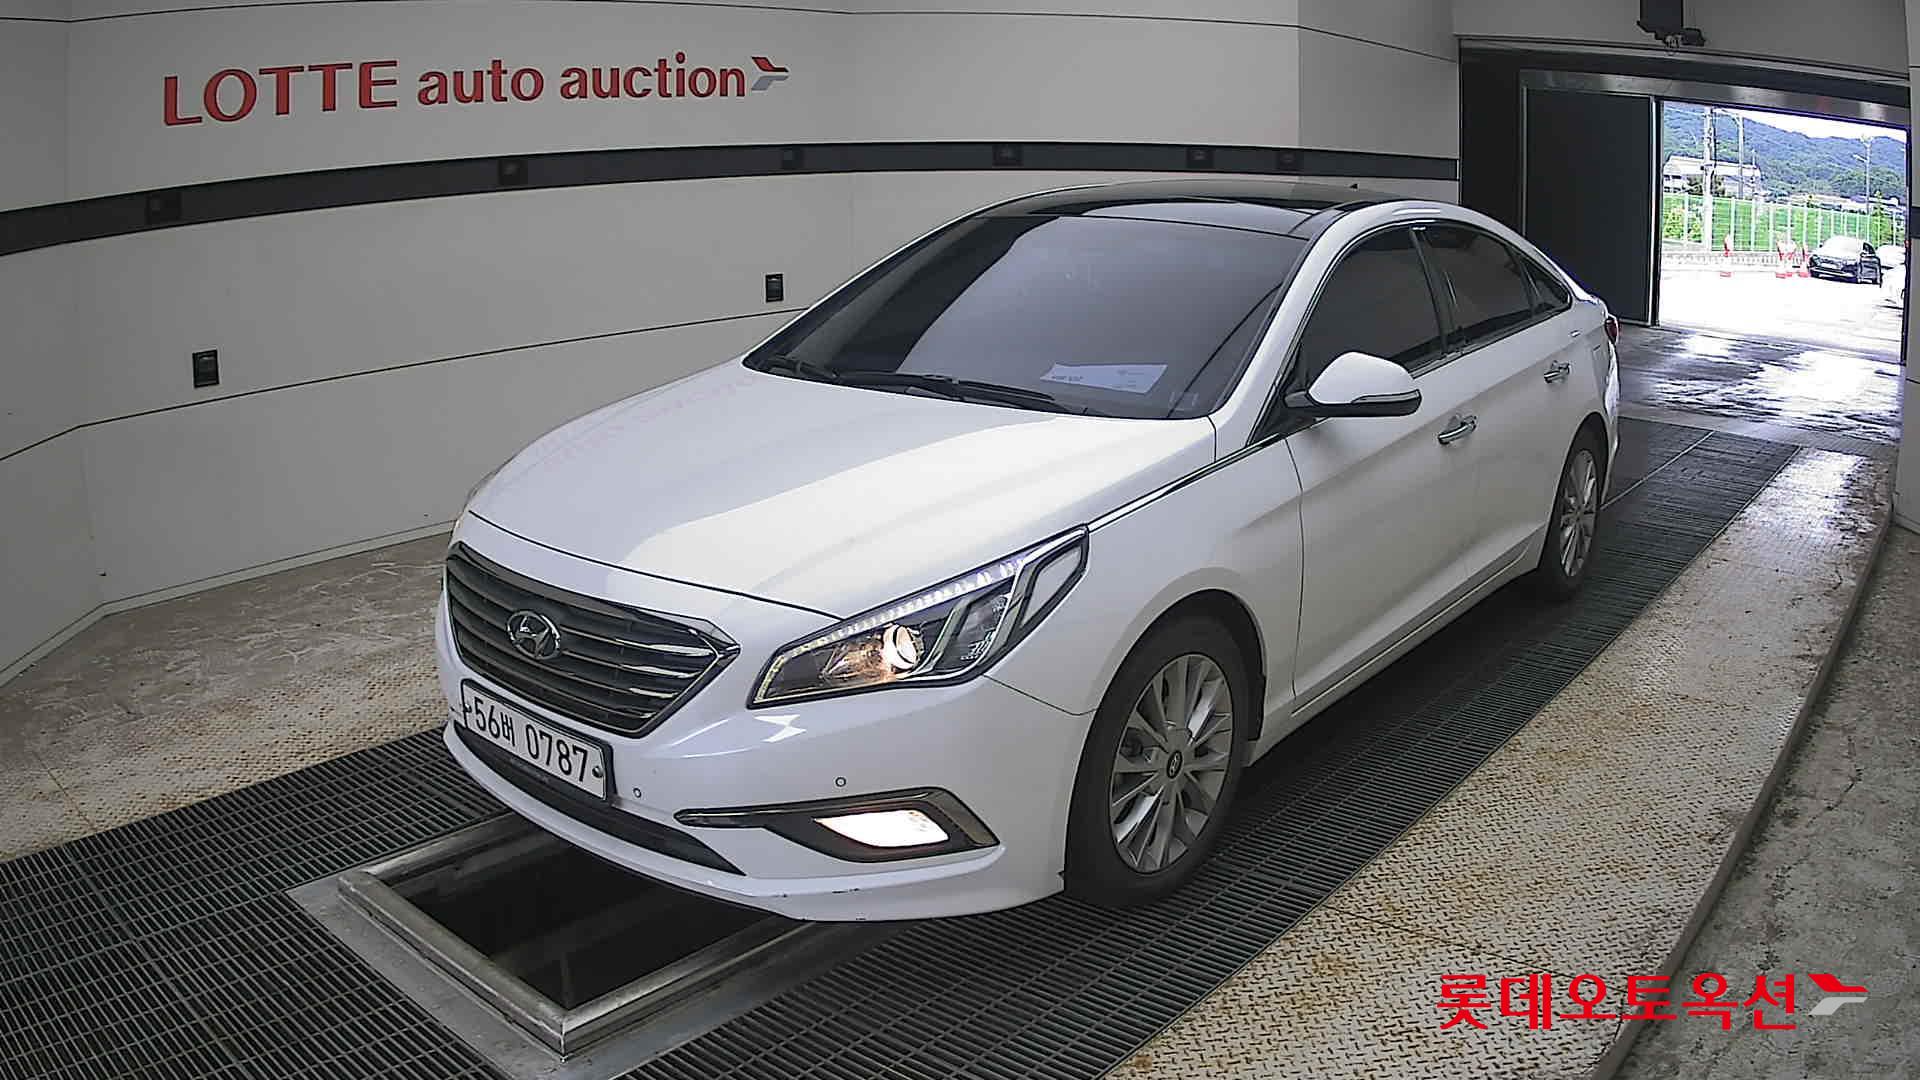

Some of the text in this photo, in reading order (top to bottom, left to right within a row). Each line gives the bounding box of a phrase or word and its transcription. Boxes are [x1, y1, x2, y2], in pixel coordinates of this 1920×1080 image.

[163, 51, 747, 126] LOTTE auto auction
[474, 696, 588, 782] 56버 0787
